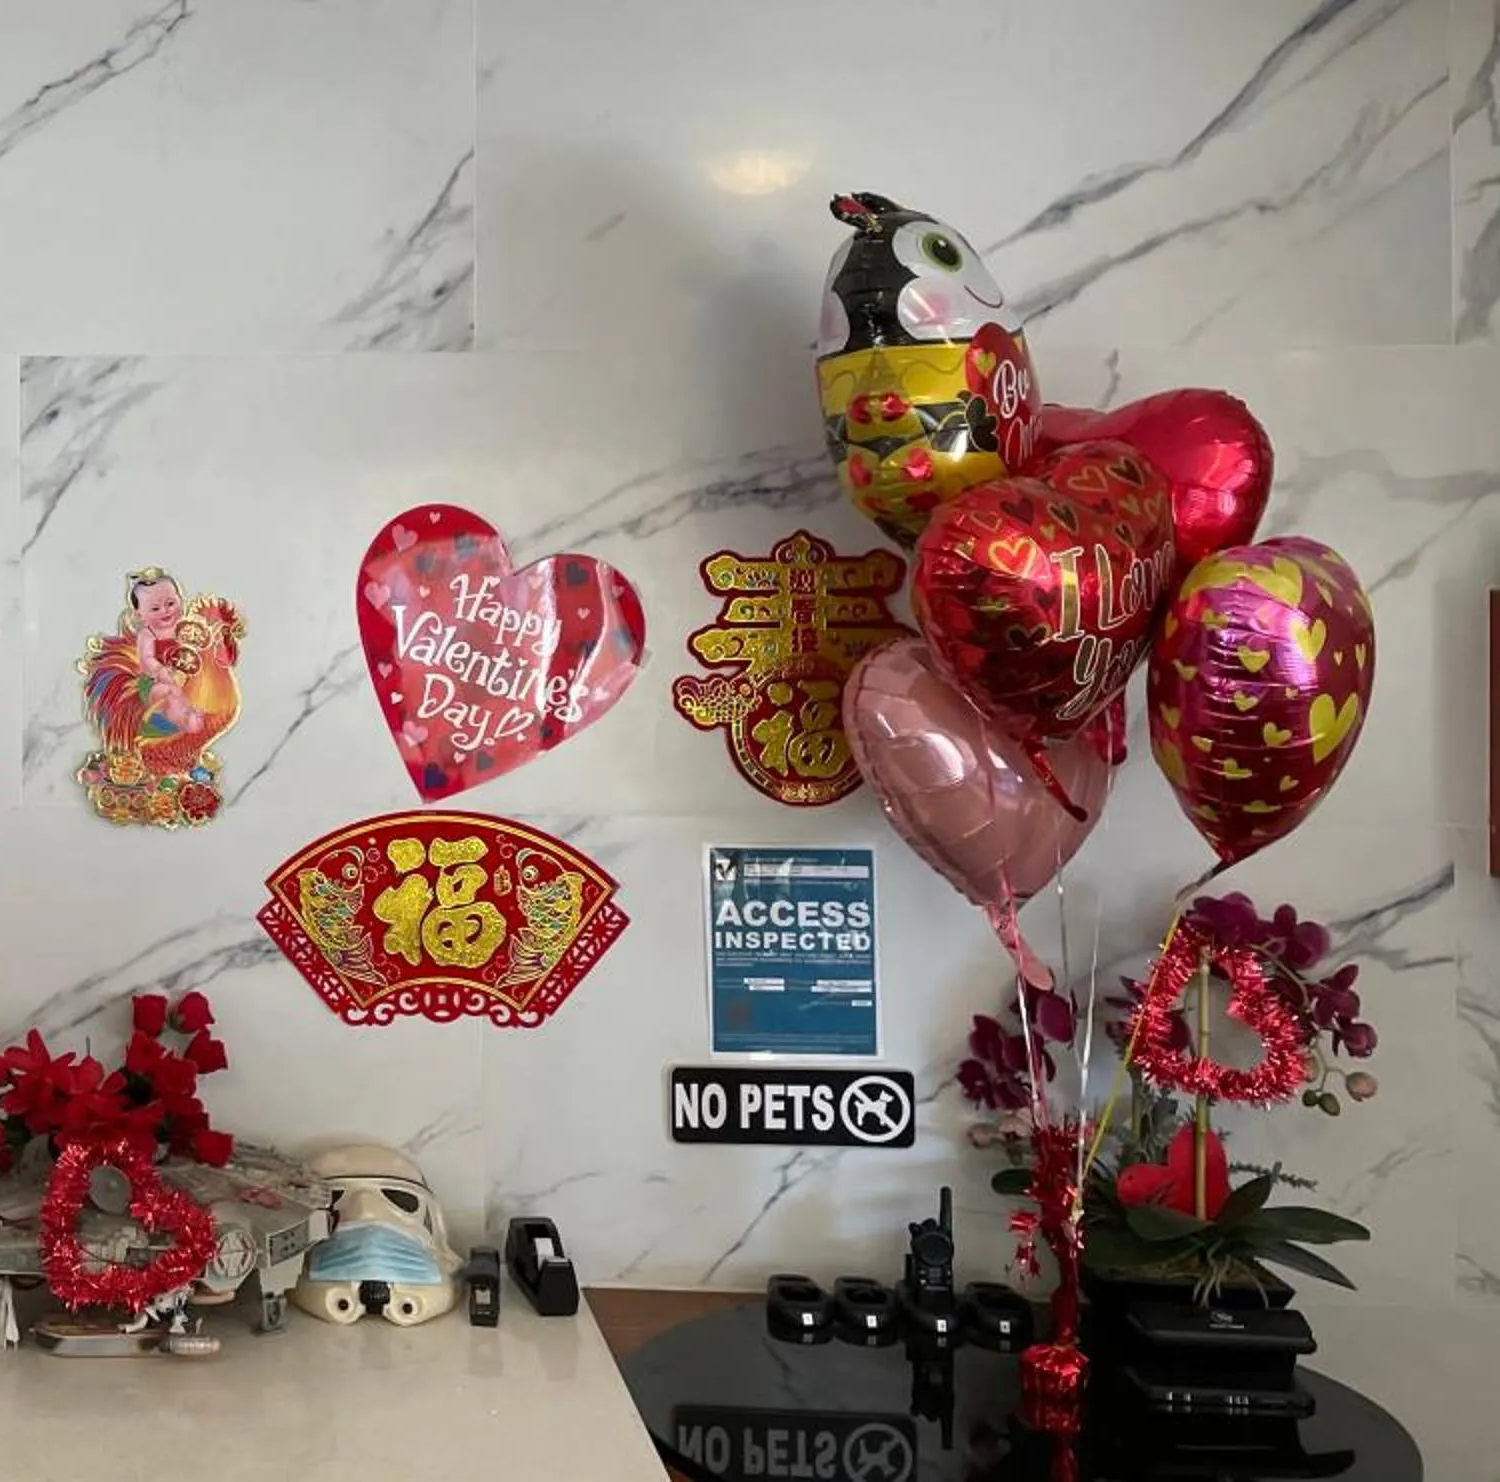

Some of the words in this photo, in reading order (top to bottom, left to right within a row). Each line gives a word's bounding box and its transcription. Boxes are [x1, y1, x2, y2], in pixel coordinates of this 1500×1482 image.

[449, 573, 562, 656] Happy
[1049, 545, 1085, 642] I
[391, 604, 590, 723] Valentine's
[372, 836, 508, 969] 福
[714, 930, 872, 951] INSPECTED
[715, 899, 871, 928] ACCESS
[674, 1082, 728, 1129] NO
[739, 1083, 835, 1132] PETS
